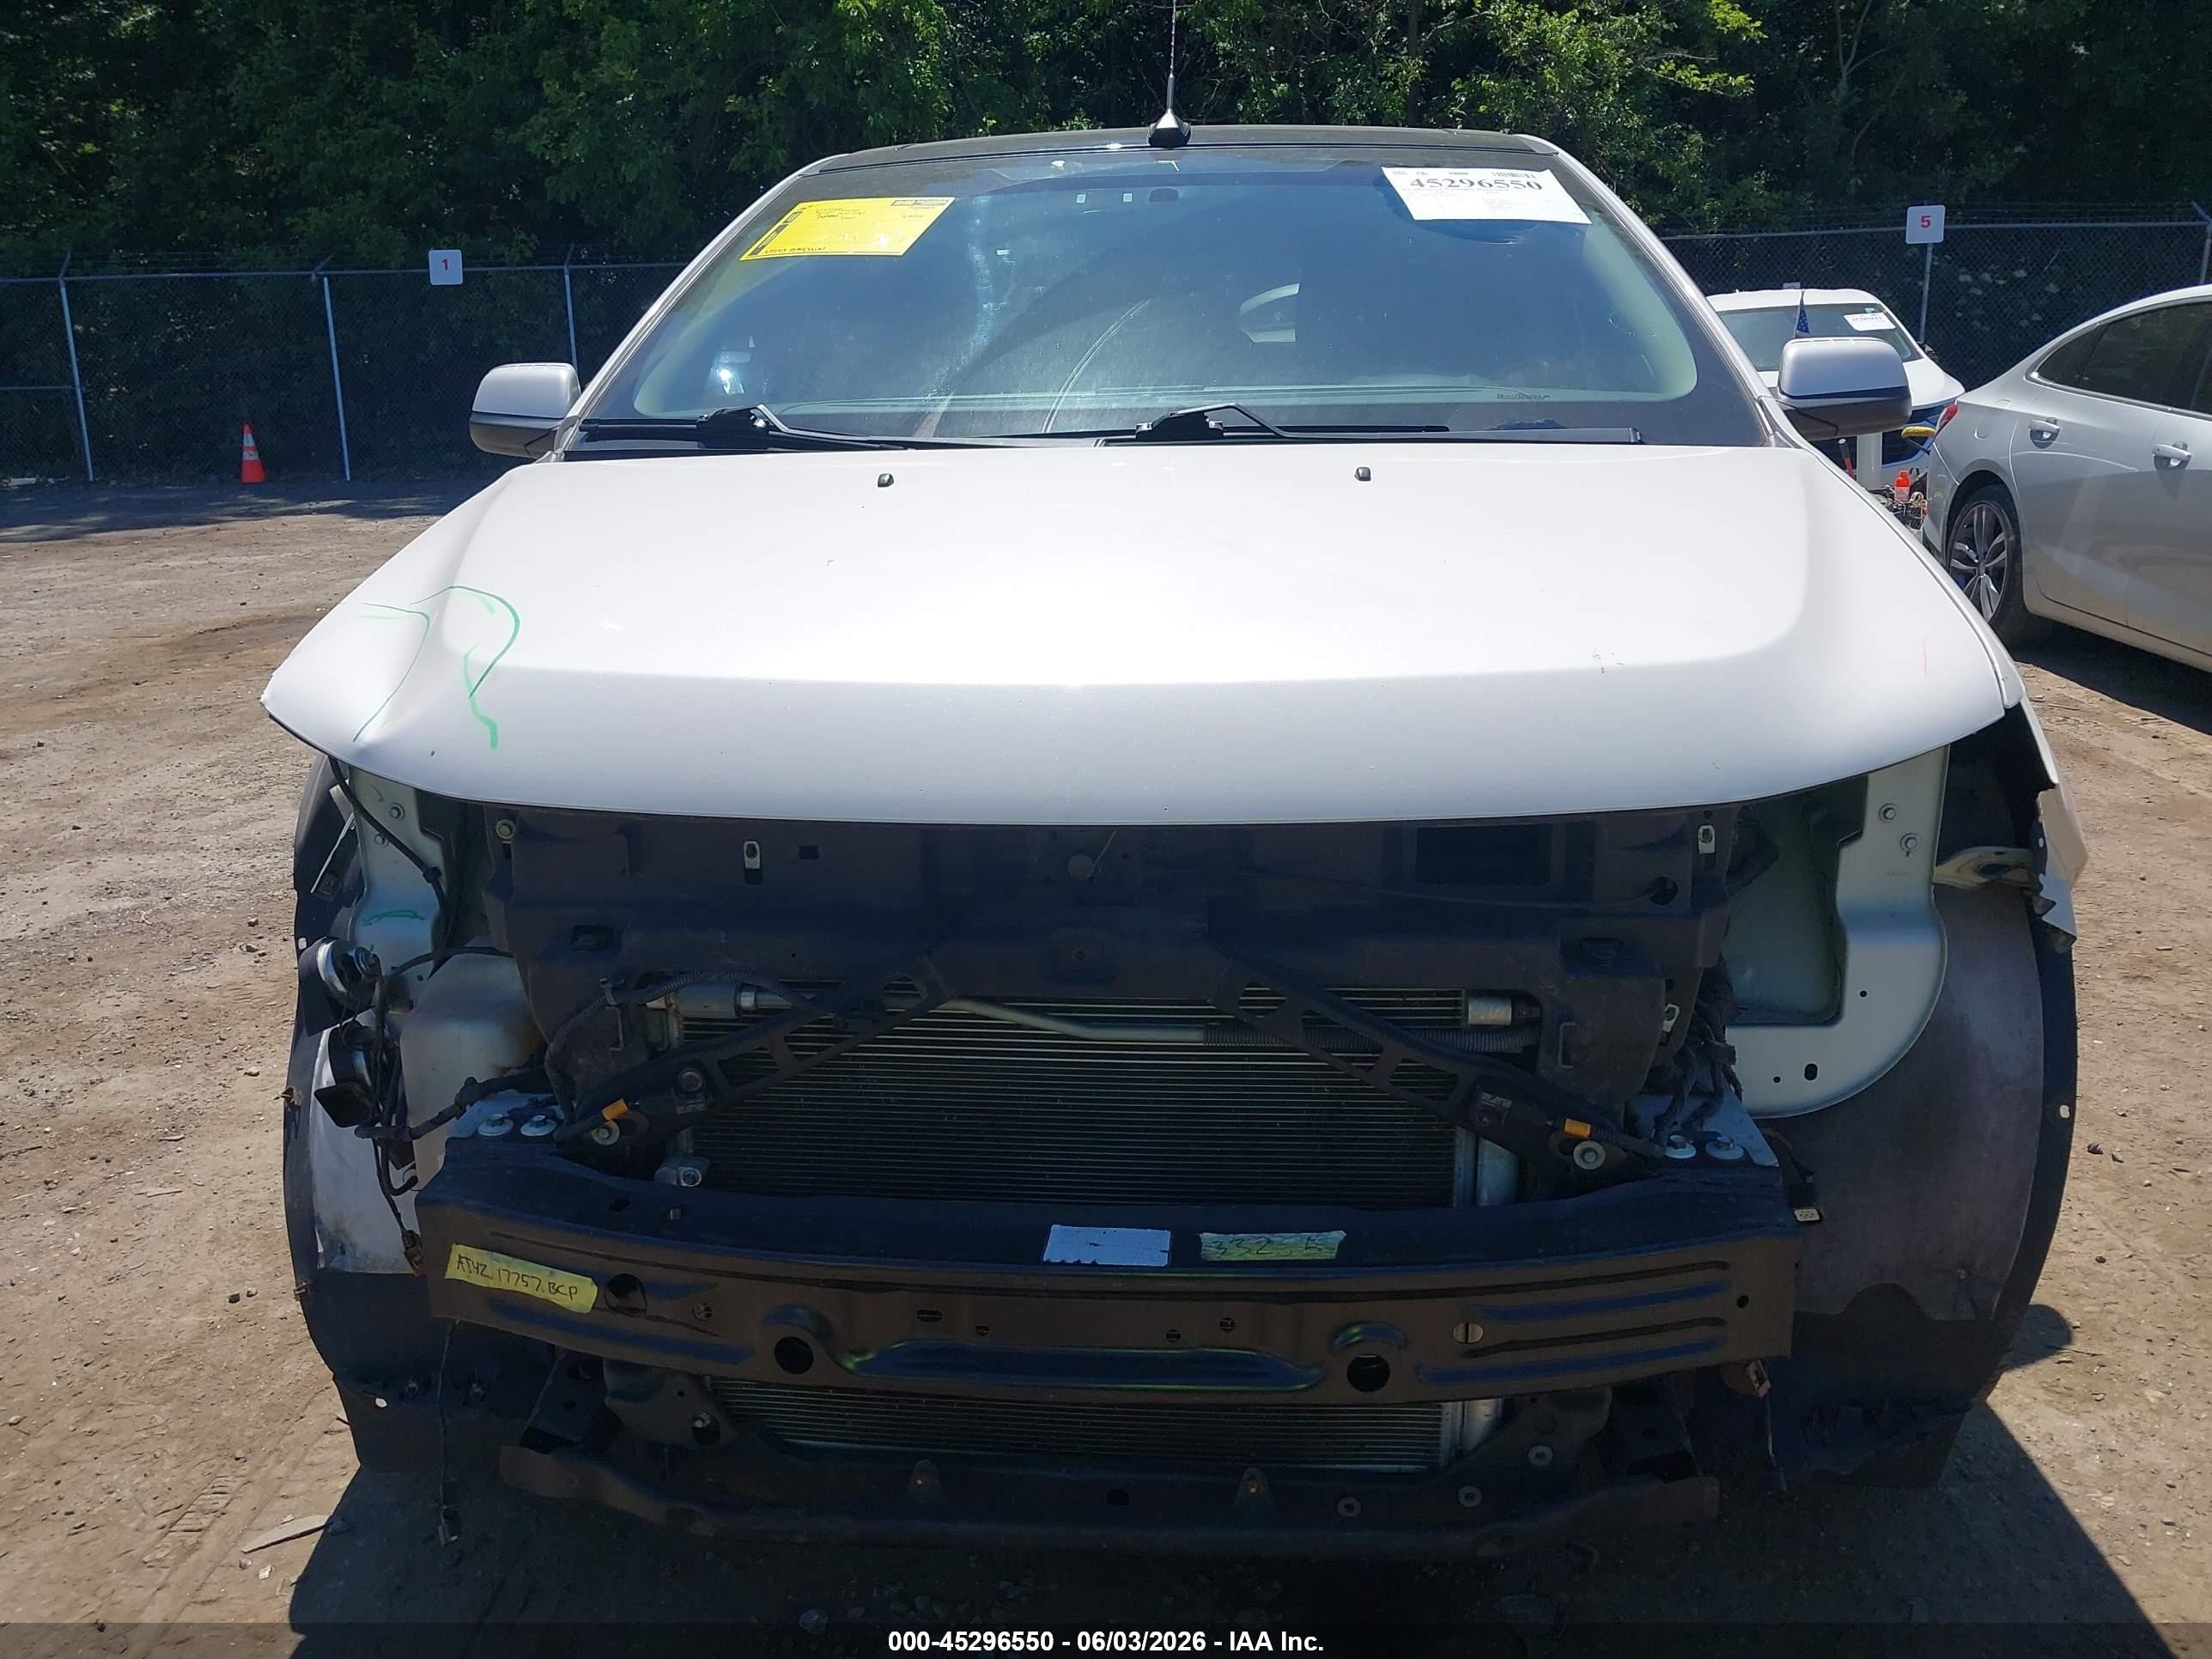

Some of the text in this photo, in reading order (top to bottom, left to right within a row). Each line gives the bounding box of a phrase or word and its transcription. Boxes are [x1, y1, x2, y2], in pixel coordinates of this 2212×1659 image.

[1409, 178, 1543, 191] 45296550
[1920, 215, 1931, 228] 5
[441, 258, 449, 270] 1
